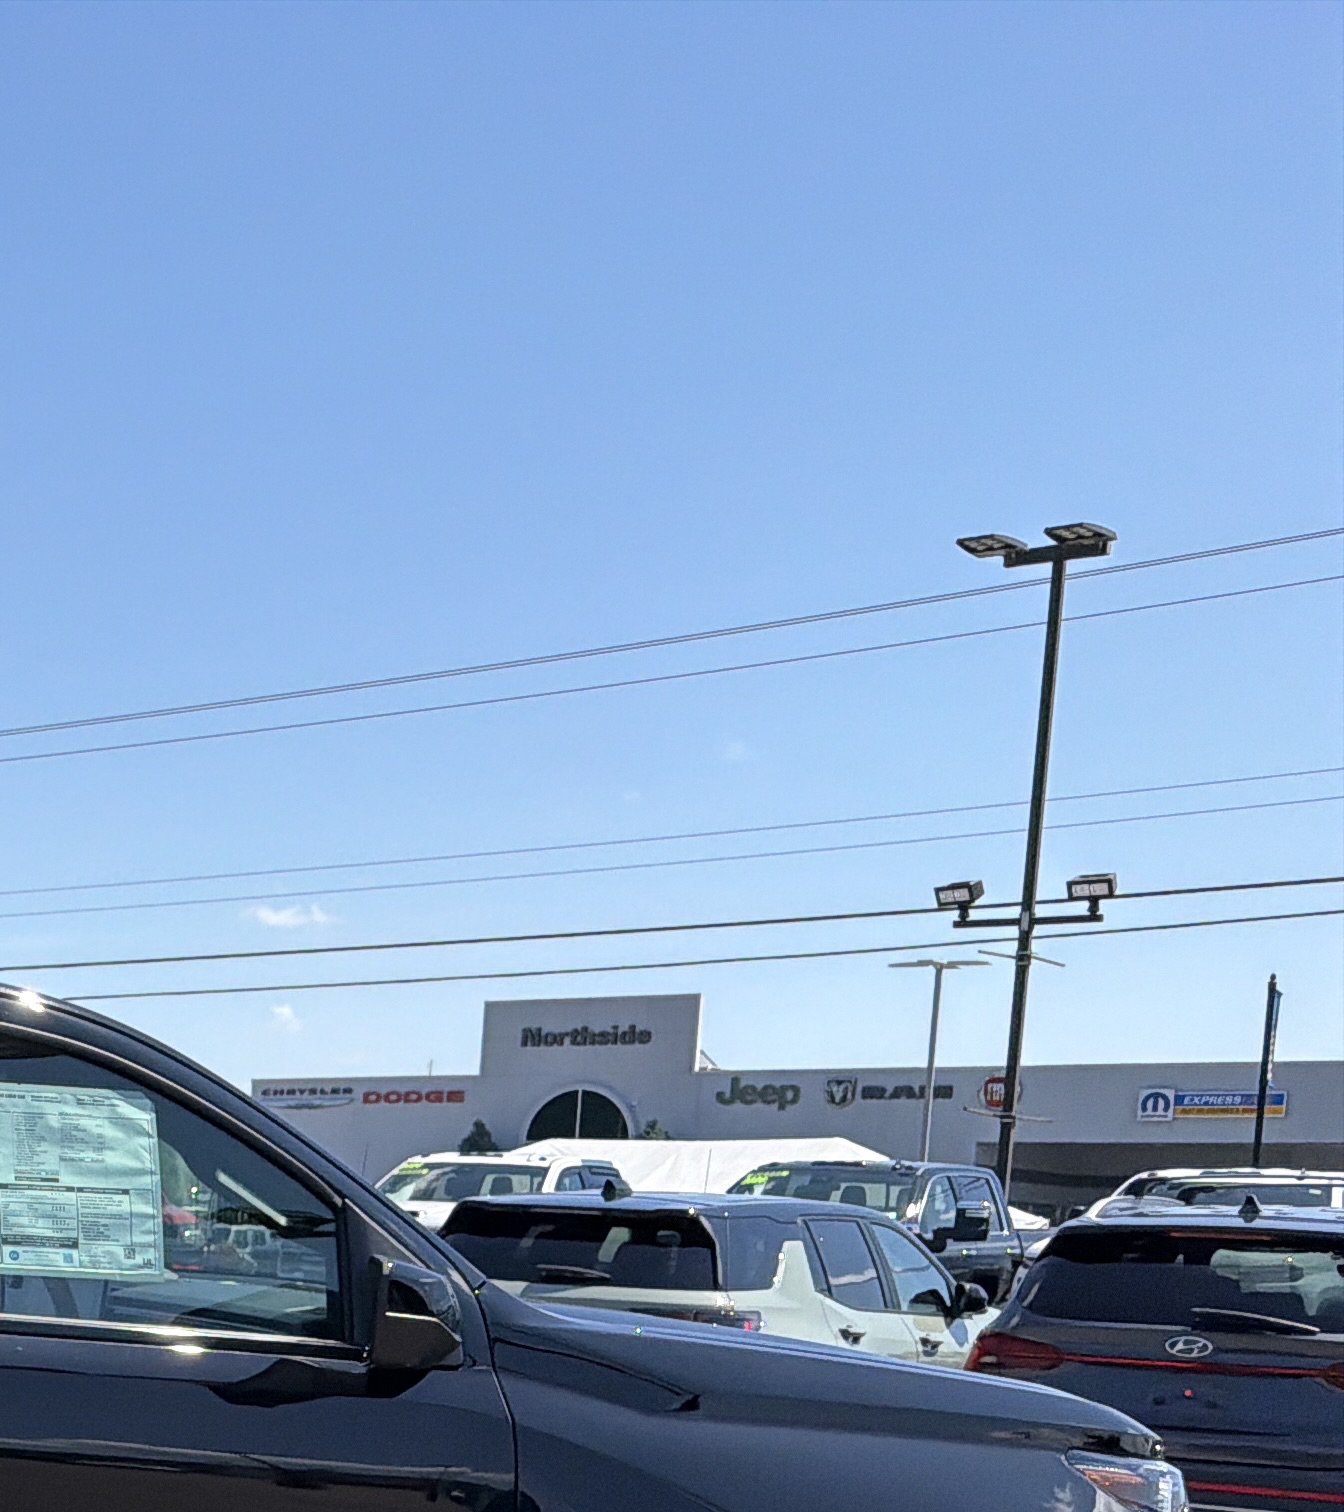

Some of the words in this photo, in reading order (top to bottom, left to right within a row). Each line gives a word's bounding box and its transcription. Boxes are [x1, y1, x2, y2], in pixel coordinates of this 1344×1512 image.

[520, 1024, 653, 1047] Northside
[261, 1087, 353, 1097] CHRYSLER
[362, 1090, 465, 1104] DODGE
[715, 1076, 801, 1111] Jeep
[1183, 1095, 1242, 1105] EXPRESS
